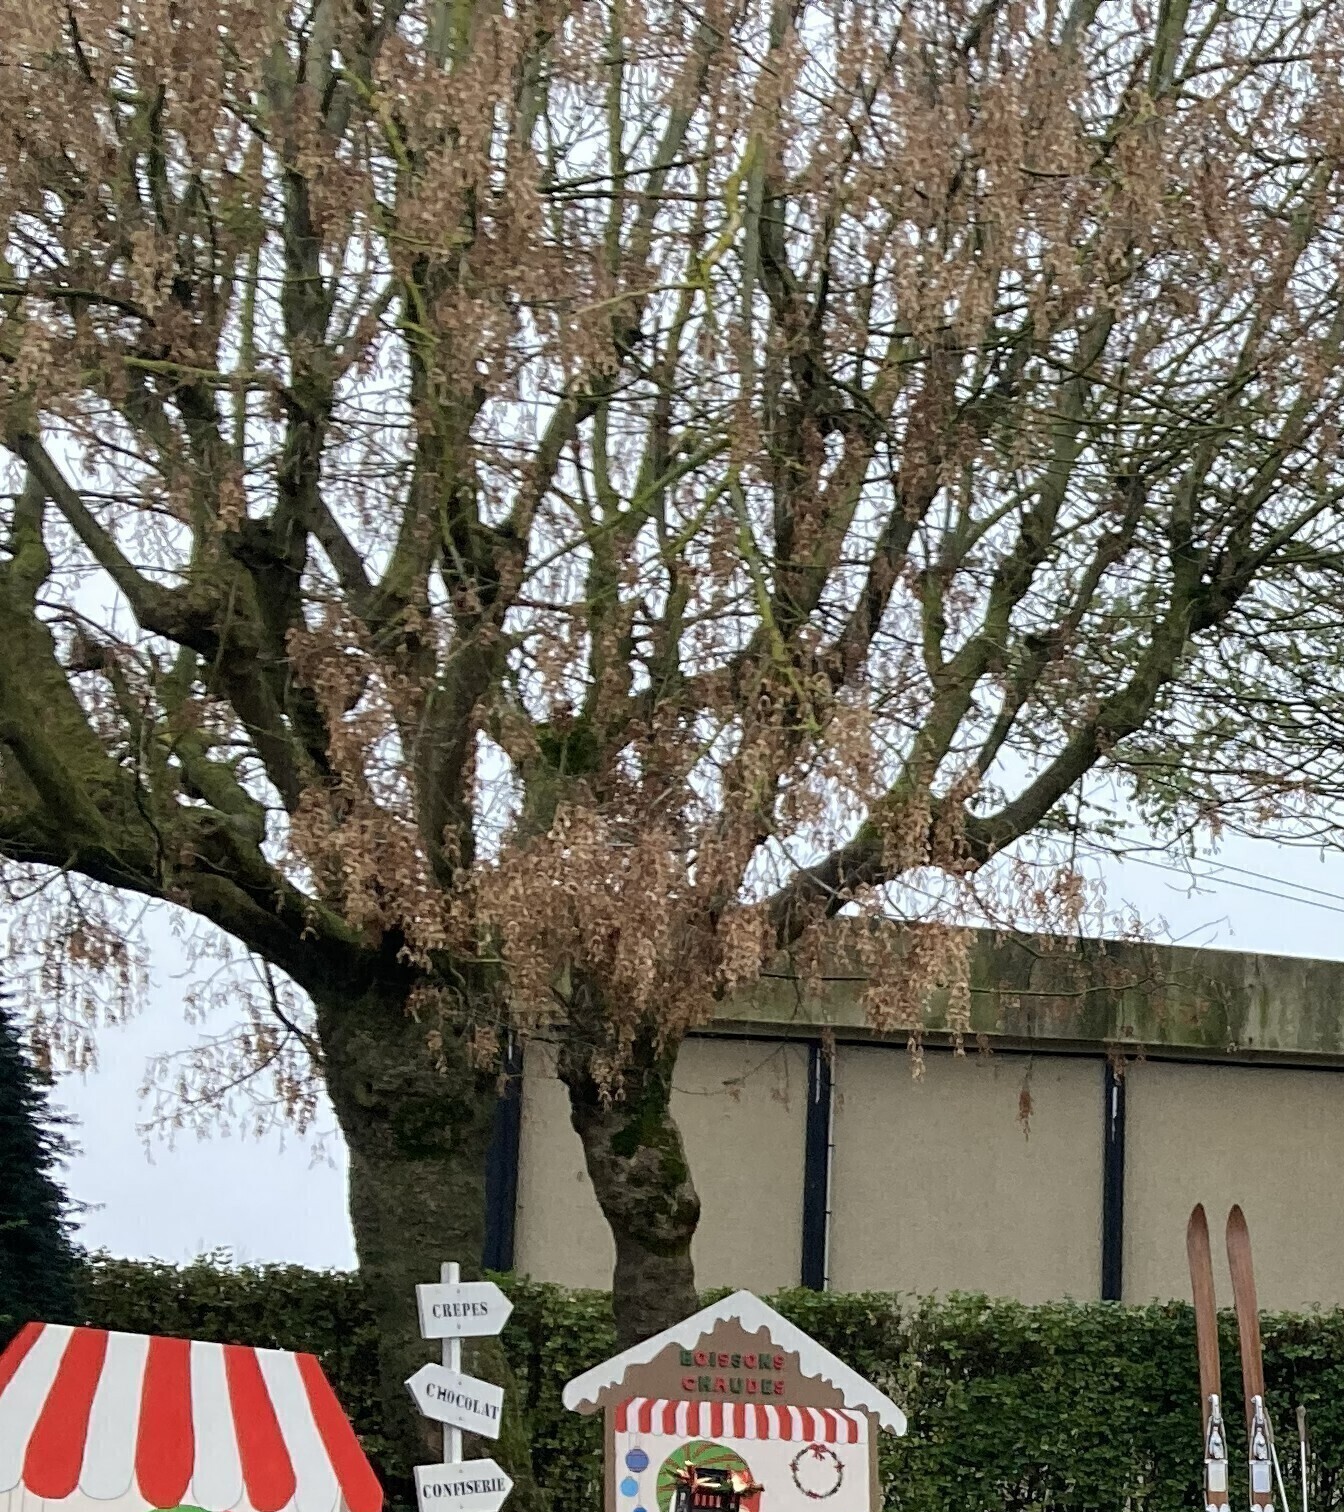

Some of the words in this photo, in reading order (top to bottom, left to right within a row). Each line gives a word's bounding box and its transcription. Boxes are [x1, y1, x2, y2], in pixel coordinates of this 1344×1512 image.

[432, 1302, 488, 1318] CREPES
[680, 1350, 785, 1371] BOISSONS
[682, 1376, 785, 1396] CHAUDES
[426, 1383, 499, 1419] CHOCOLAT
[423, 1478, 506, 1499] CONFISERIE
